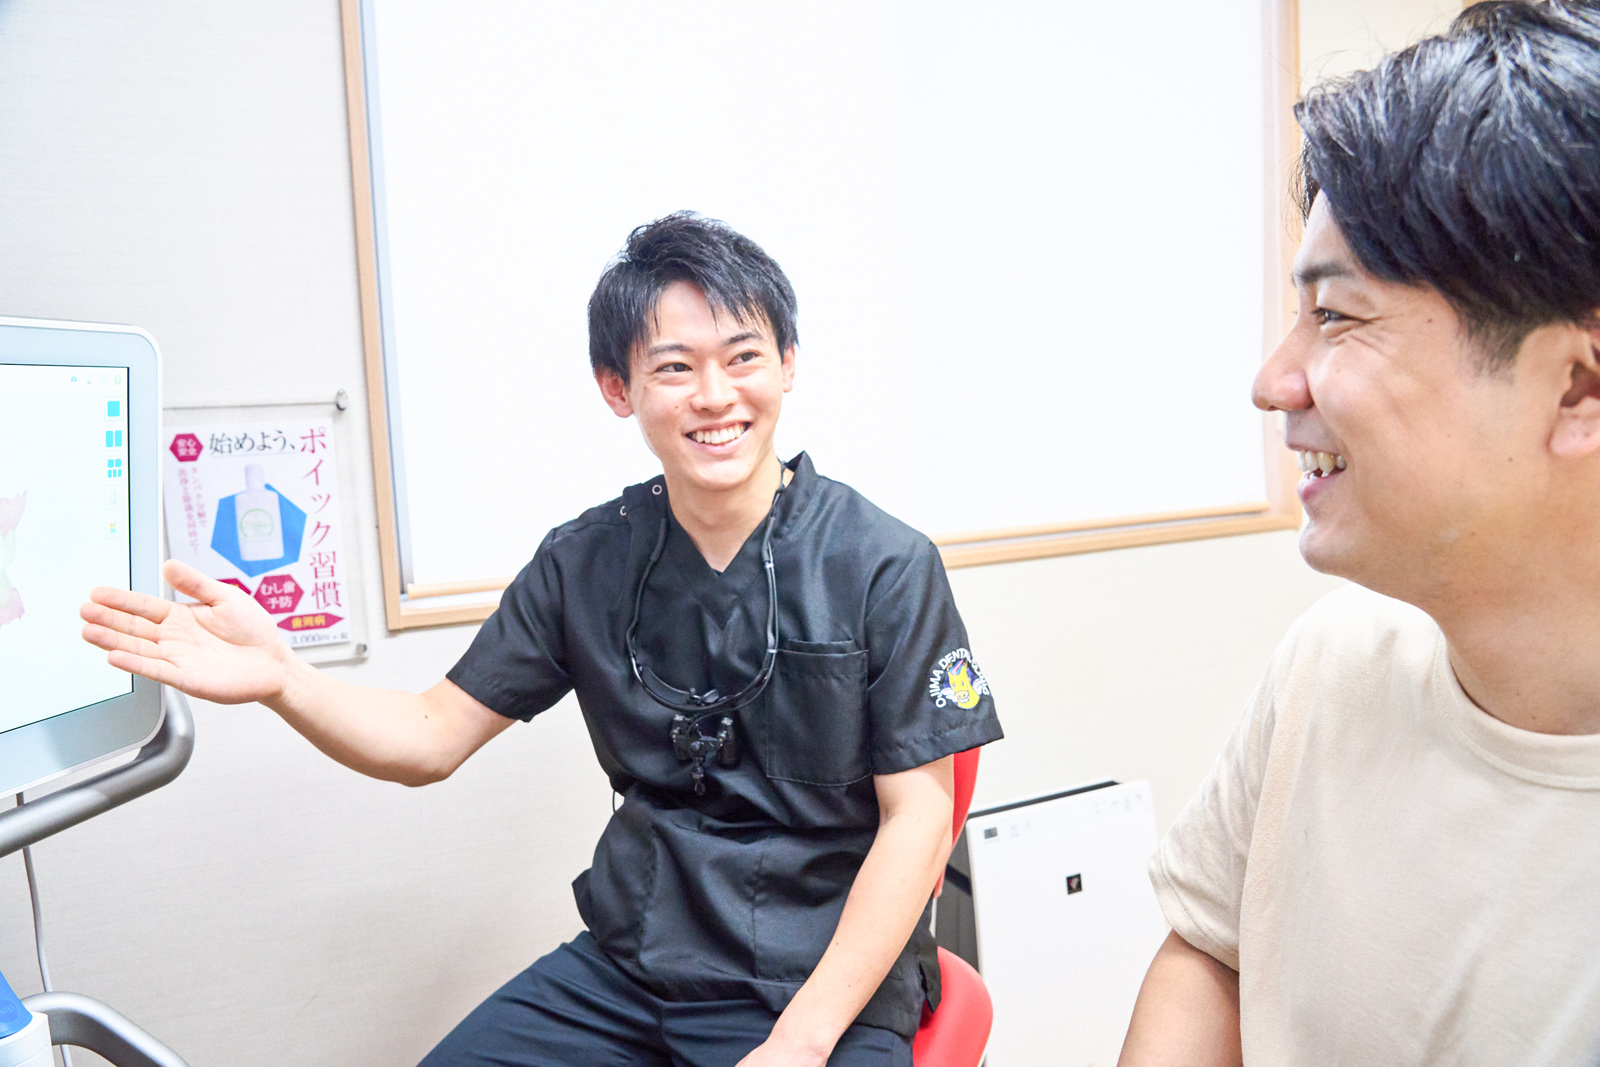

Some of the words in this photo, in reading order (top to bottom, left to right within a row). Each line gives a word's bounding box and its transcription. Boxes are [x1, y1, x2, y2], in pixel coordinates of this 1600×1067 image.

[209, 429, 297, 456] 始めよう、
[300, 426, 342, 610] ポイック習慣
[260, 581, 295, 596] むし歯
[266, 596, 293, 610] 予防
